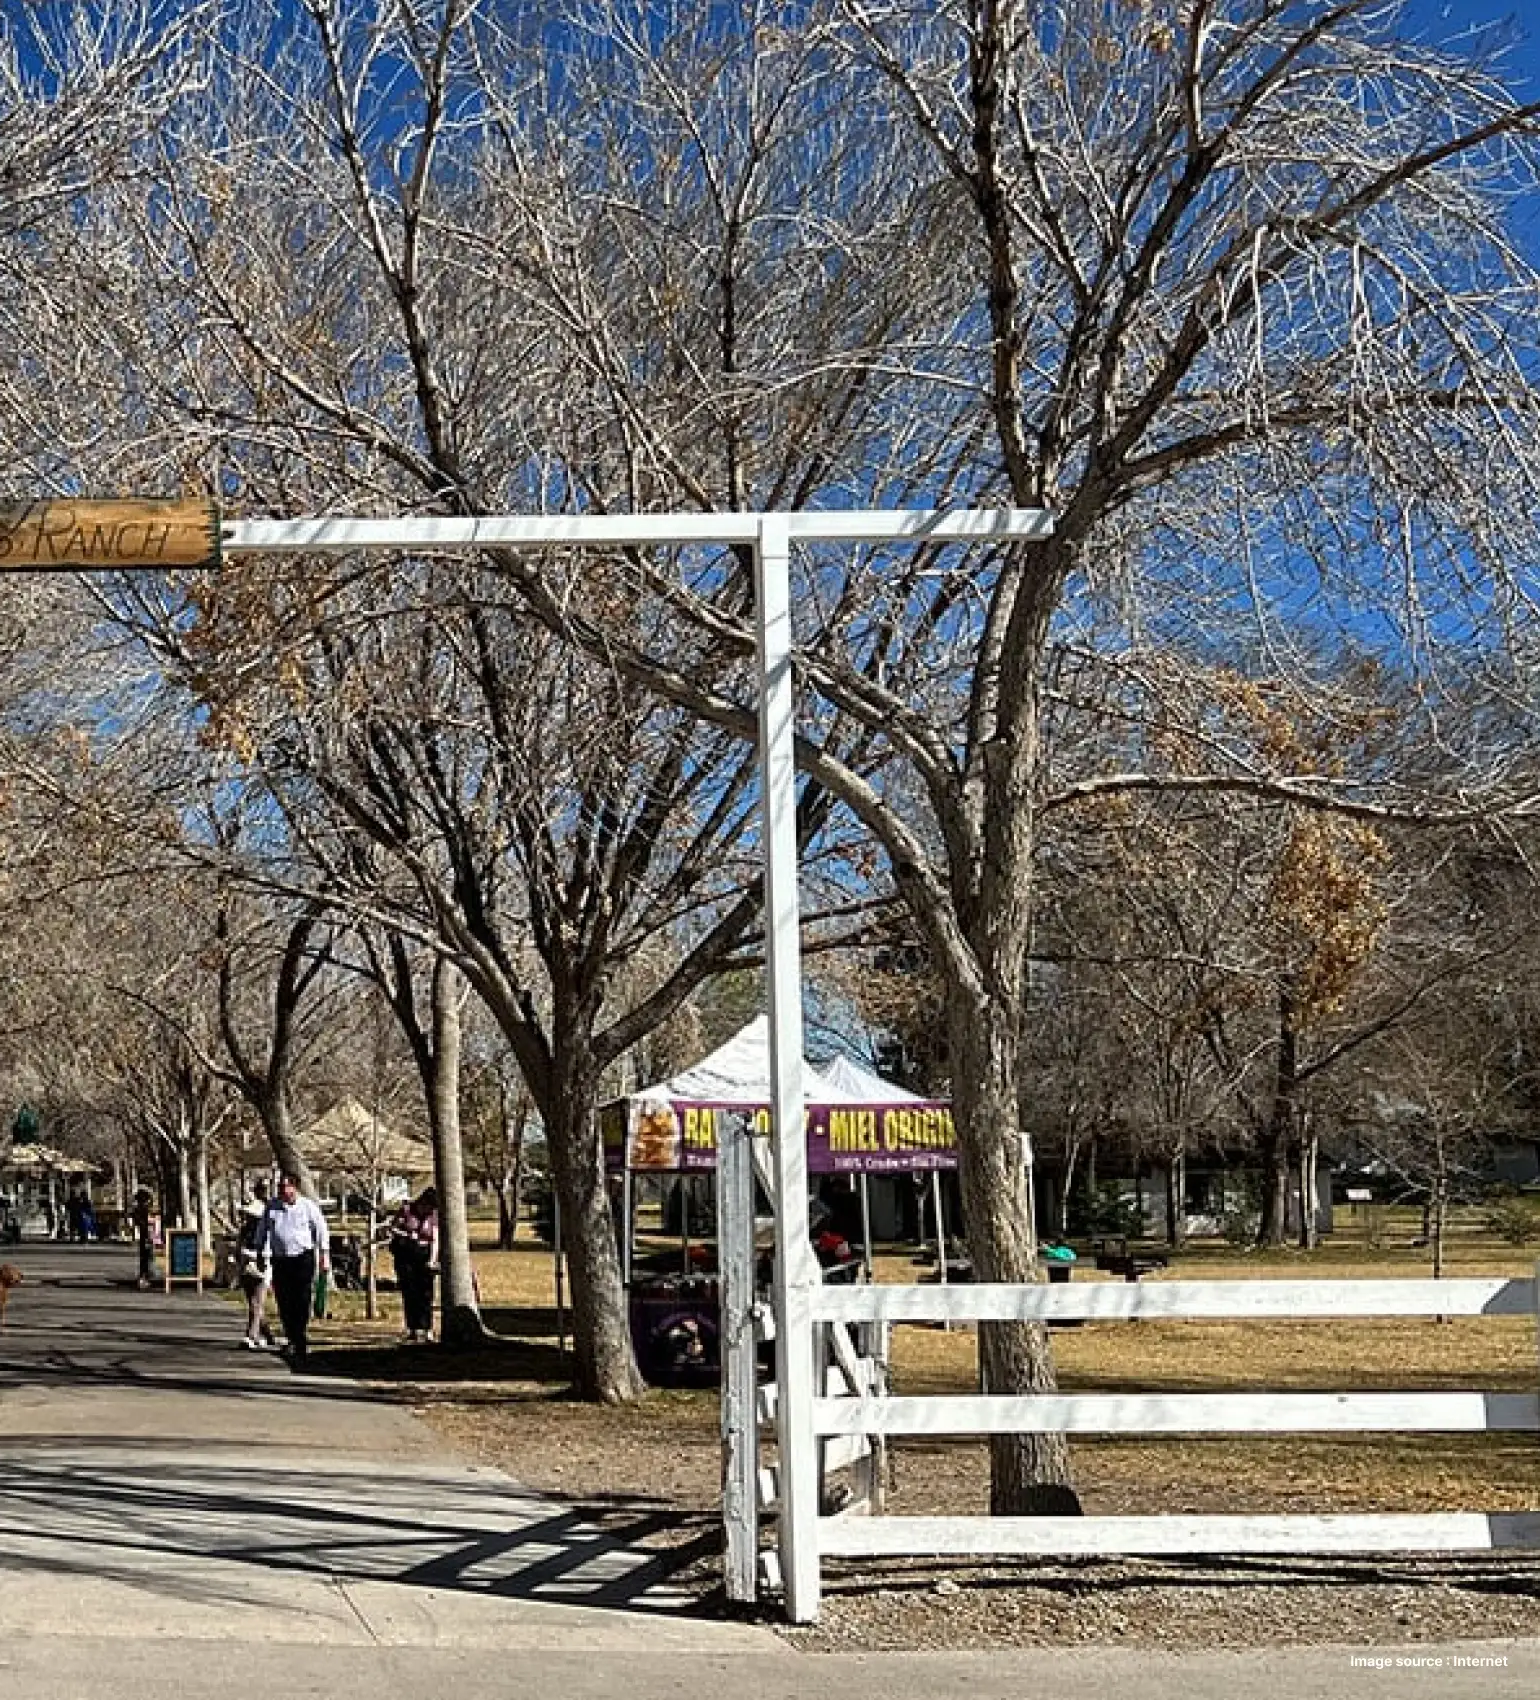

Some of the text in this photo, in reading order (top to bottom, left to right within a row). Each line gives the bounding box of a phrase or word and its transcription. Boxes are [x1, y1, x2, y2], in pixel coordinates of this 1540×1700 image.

[34, 506, 171, 560] RANCH
[684, 1108, 716, 1149] RA
[829, 1109, 880, 1151] MIEL
[884, 1108, 957, 1152] ORIGIN
